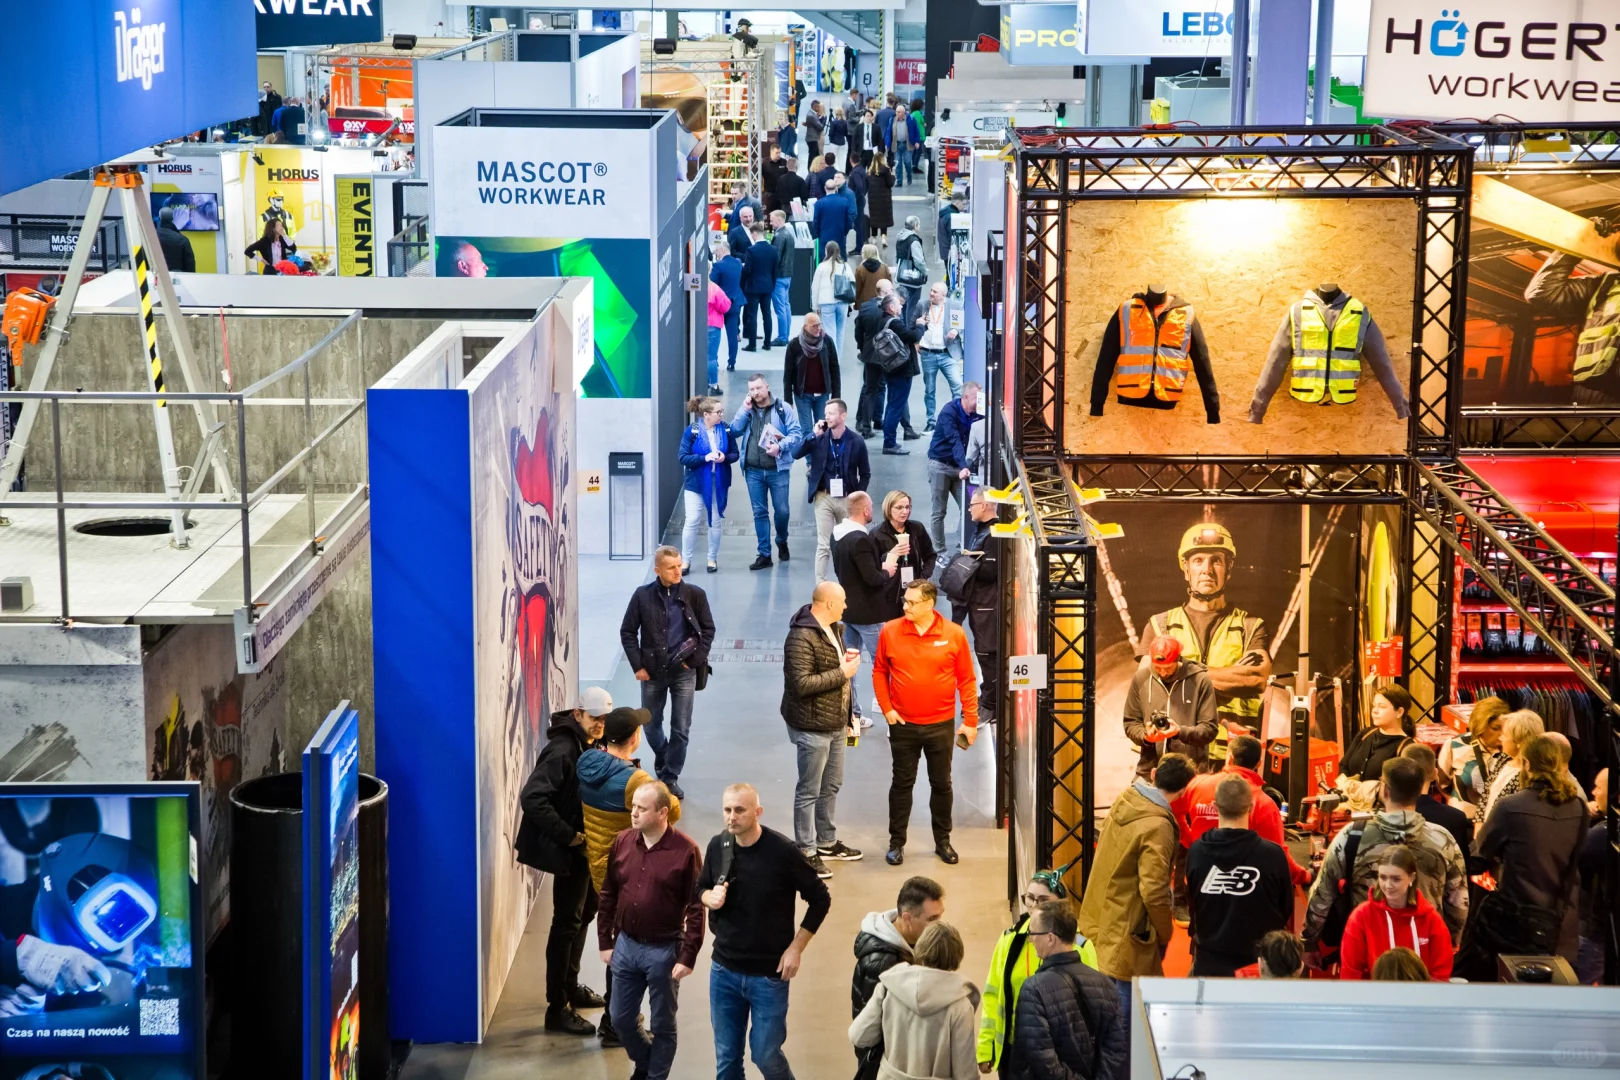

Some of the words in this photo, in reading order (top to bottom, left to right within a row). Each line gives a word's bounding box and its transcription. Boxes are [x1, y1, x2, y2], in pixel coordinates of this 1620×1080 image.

[255, 0, 374, 16] WEAR
[1162, 12, 1234, 36] LEB
[1386, 9, 1620, 61] HÖGER
[114, 8, 166, 90] Dräger
[898, 61, 922, 70] MUZ
[158, 164, 193, 173] HORUS
[268, 168, 320, 182] HORUS
[477, 160, 608, 183] MASCOT®
[478, 187, 606, 206] WORKWEAR
[691, 277, 700, 285] 45
[588, 475, 600, 485] 44
[516, 502, 554, 584] SAFETY
[1013, 664, 1029, 676] 46
[7, 1027, 34, 1038] Czas
[36, 1028, 51, 1037] na
[53, 1028, 85, 1039] naszą
[88, 1025, 130, 1037] nowość
